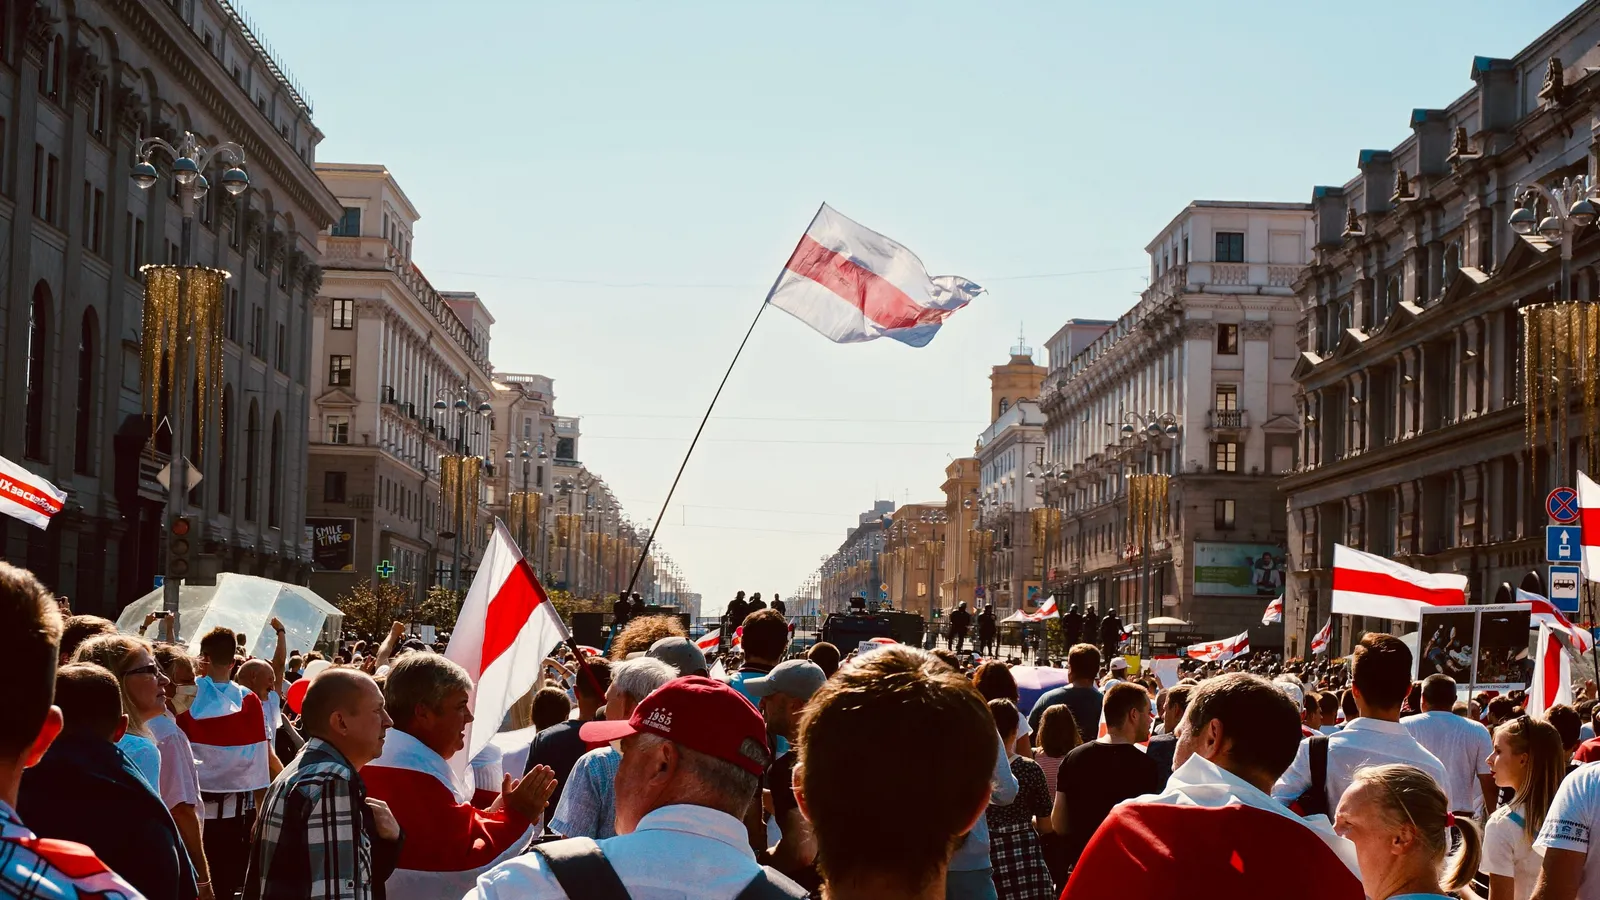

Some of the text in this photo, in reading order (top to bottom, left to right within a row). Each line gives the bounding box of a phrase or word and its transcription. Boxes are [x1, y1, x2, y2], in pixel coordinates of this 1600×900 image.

[316, 525, 343, 538] SMILE
[318, 534, 342, 546] TIME
[648, 711, 672, 726] 1985
